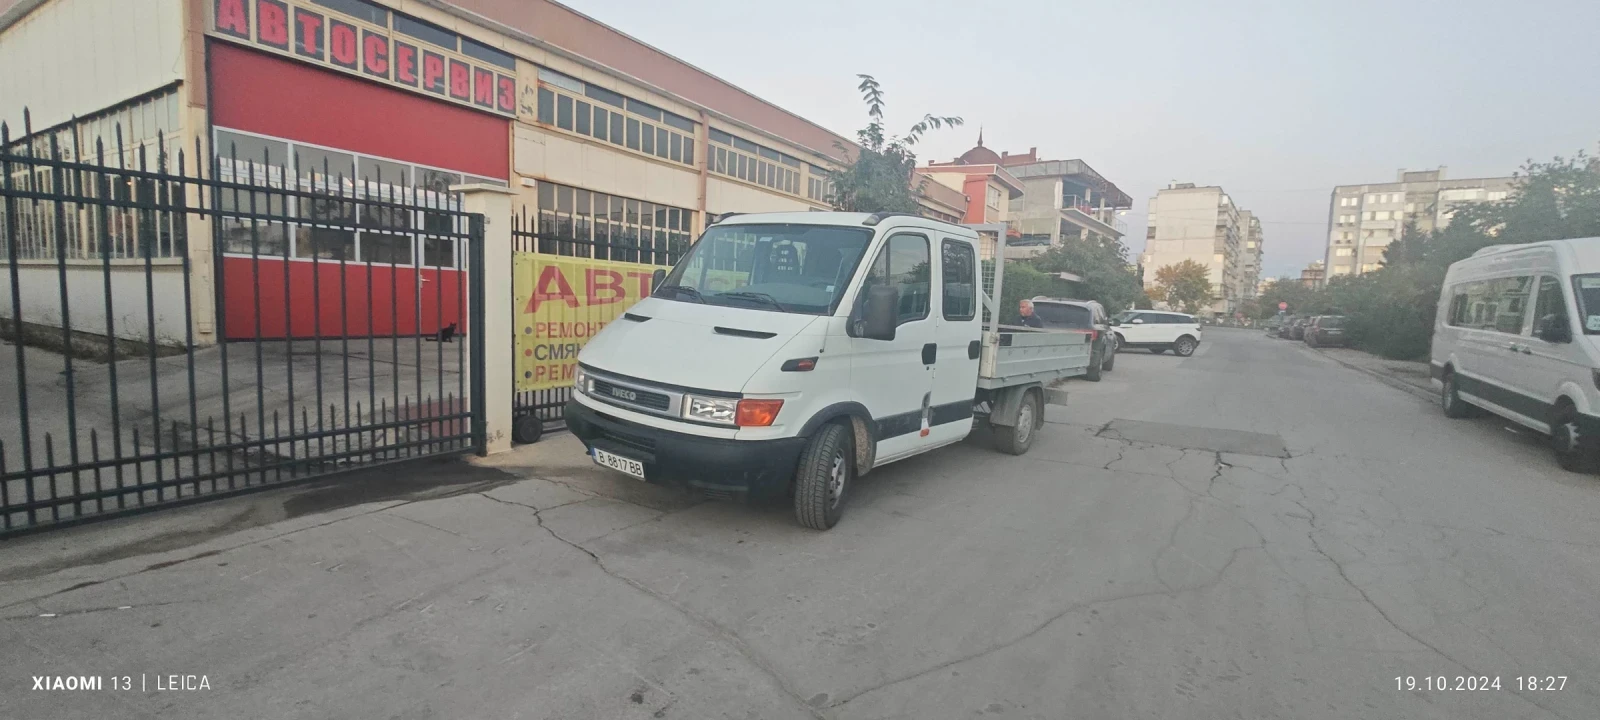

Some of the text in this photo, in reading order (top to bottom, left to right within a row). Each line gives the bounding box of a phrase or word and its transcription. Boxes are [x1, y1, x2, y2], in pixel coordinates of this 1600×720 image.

[216, 0, 515, 111] АВТОСЕРВИЗ
[612, 387, 637, 401] IVECO
[607, 454, 627, 471] 8817
